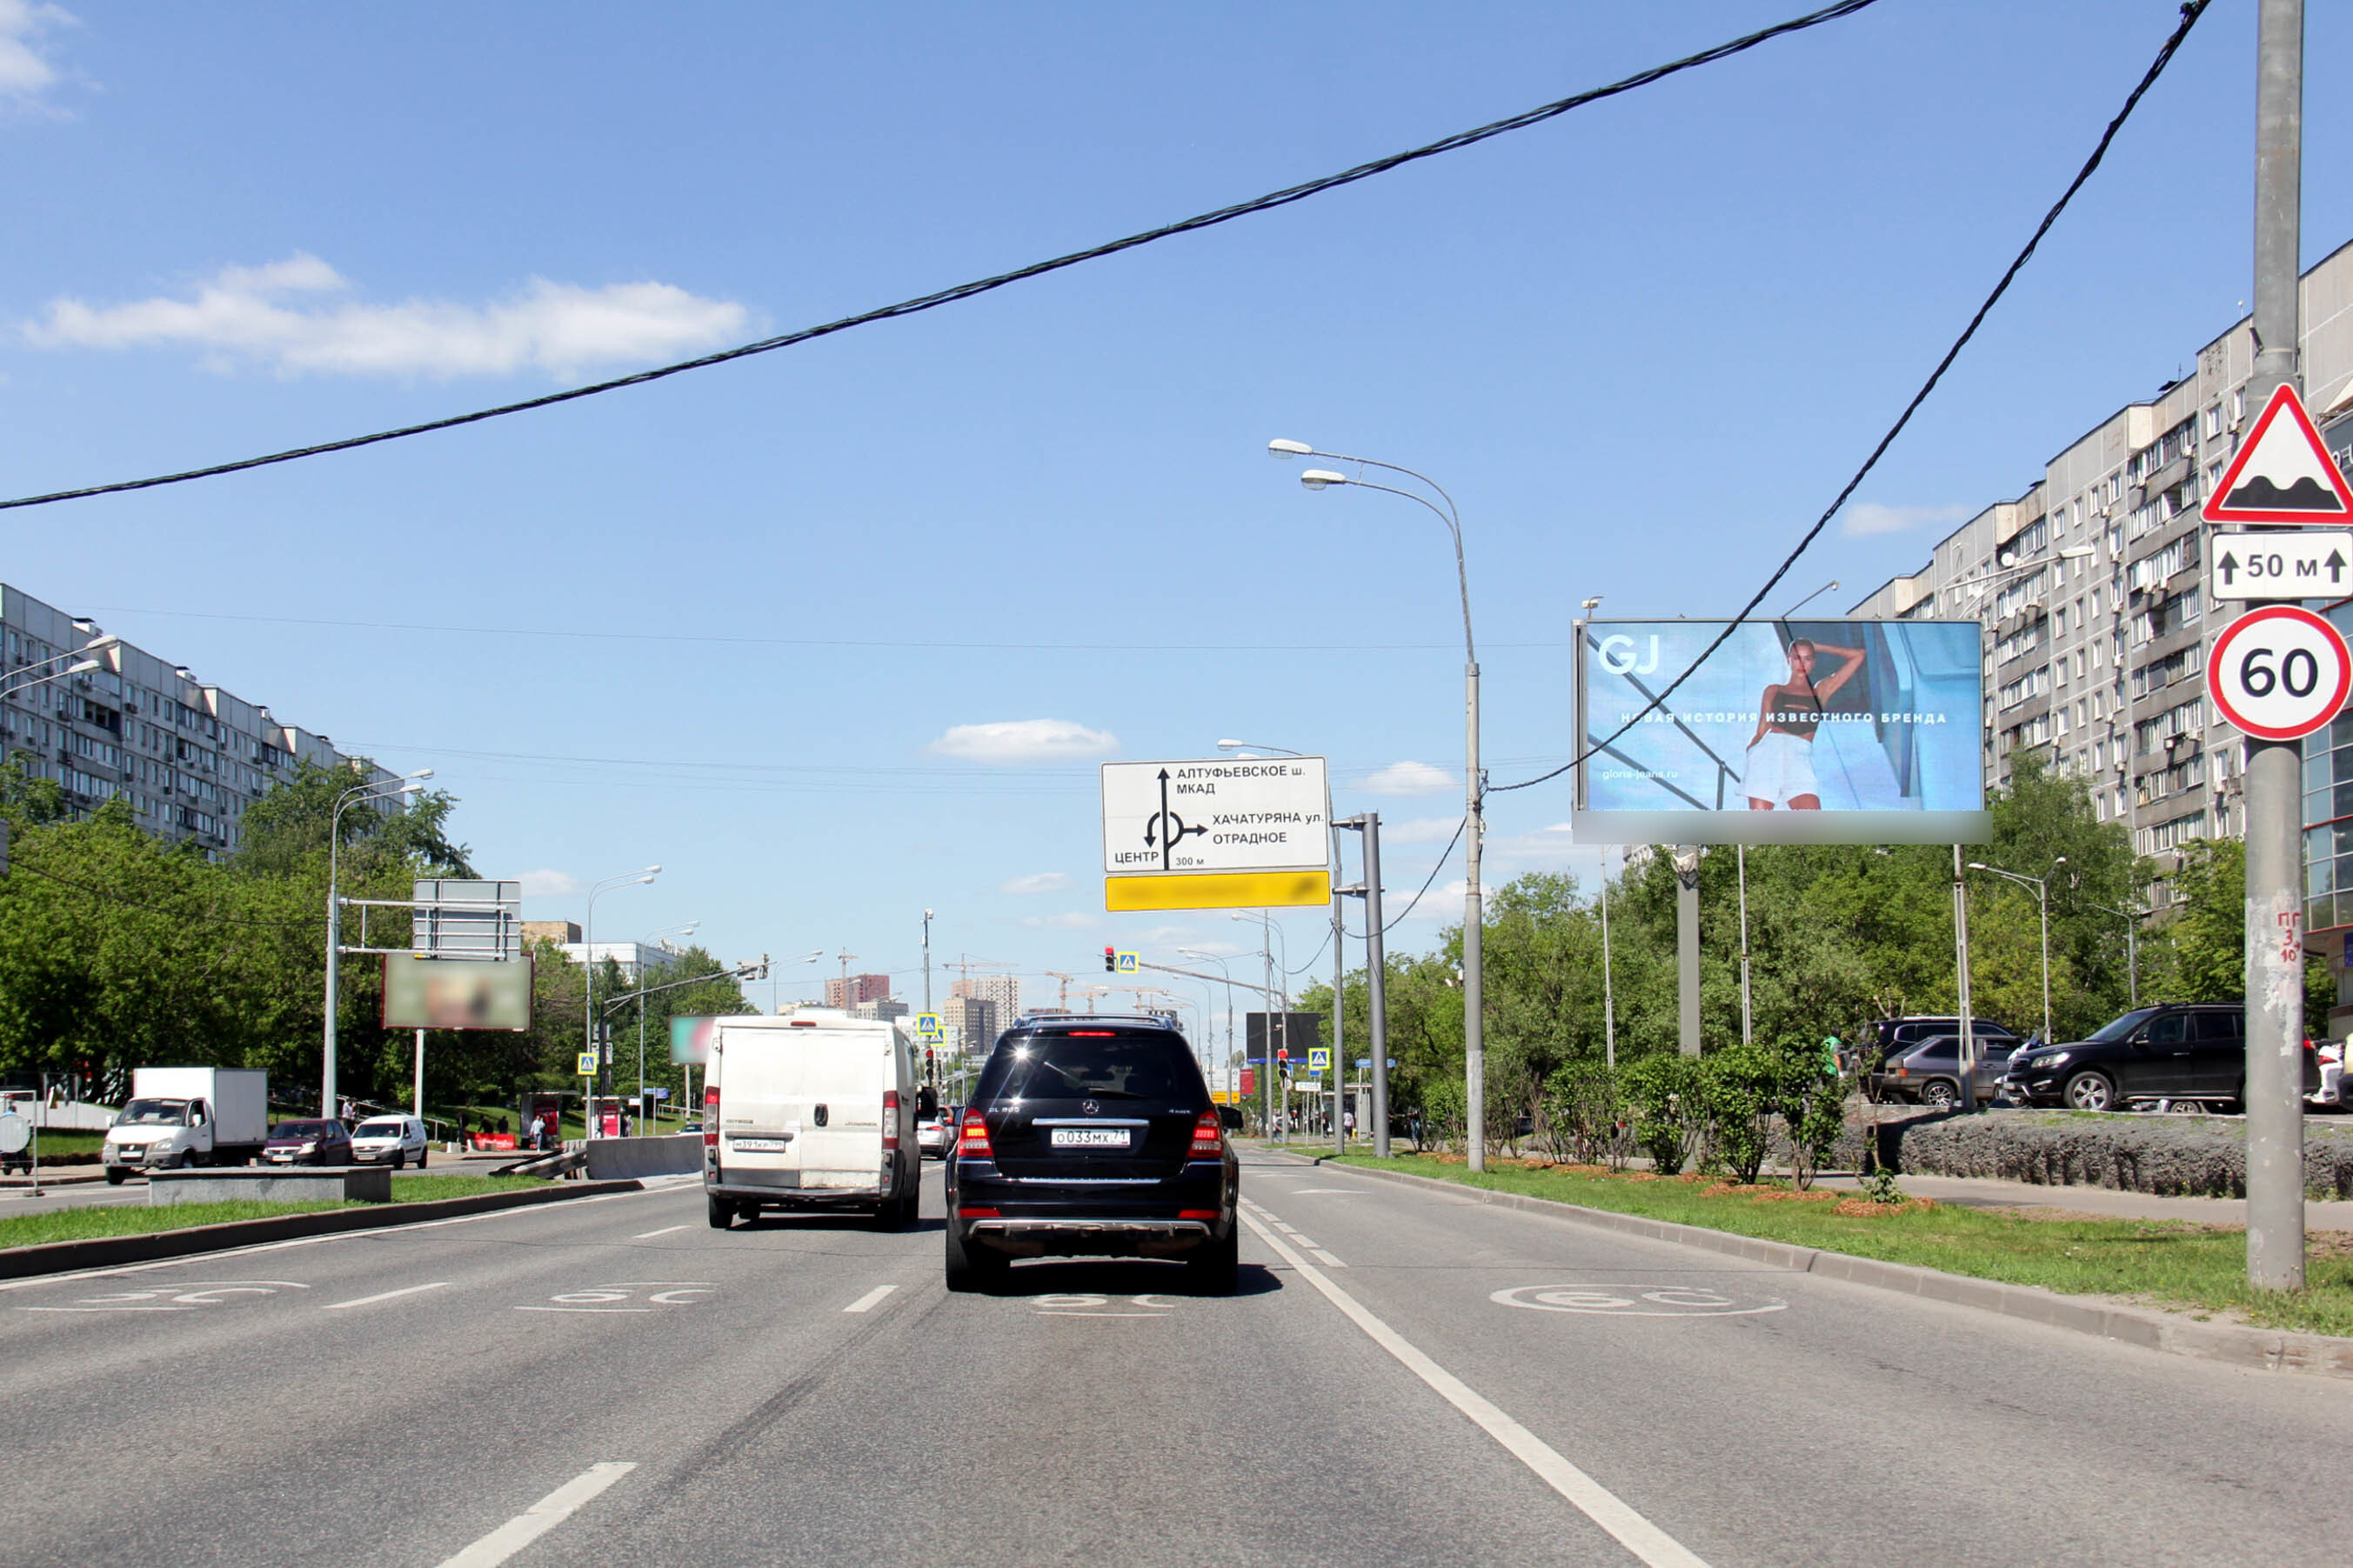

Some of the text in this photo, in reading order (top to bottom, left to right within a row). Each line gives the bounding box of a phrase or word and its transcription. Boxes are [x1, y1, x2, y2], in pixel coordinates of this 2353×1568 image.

[2247, 553, 2283, 577] 50
[1598, 634, 1659, 675] GJ
[2239, 647, 2319, 697] 60
[1682, 712, 1758, 724] ИСТОРИЯ
[1765, 712, 1874, 724] ИЗВЕСТНОГО
[1881, 712, 1948, 724] БРЕНДА
[1177, 765, 1287, 779] АЛТУФЬЕВСКОЕ
[1176, 783, 1216, 795] МКАД
[1213, 812, 1325, 825] ХАЧАТУРЯНА ул.
[1213, 832, 1287, 845] ОТРАДНОЕ
[1114, 851, 1160, 864] ЦЕНТР
[1175, 857, 1193, 866] 300
[2277, 911, 2301, 927] ПГ
